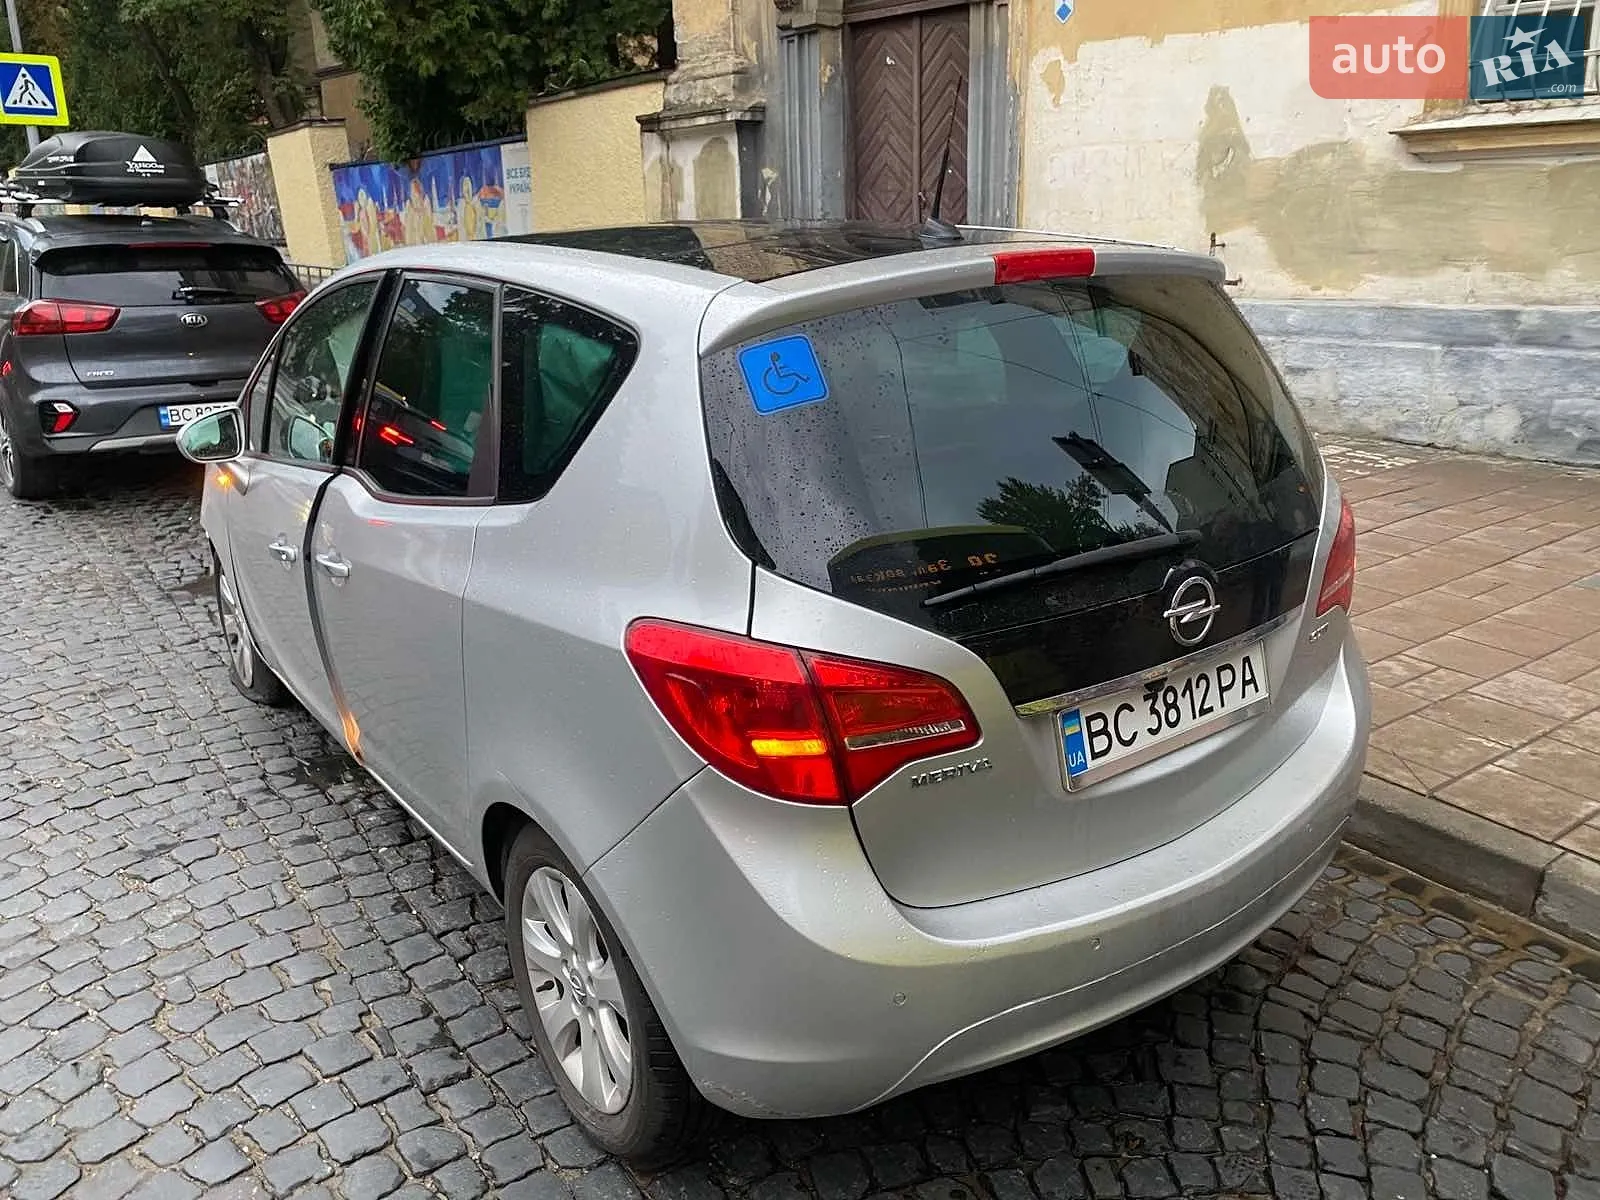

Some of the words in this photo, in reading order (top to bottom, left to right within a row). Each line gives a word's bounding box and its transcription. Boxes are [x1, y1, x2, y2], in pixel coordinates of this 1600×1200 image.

[183, 315, 205, 325] KIA
[1086, 703, 1138, 760] BC
[1143, 672, 1214, 735] 3812
[1216, 655, 1260, 708] PA
[1069, 751, 1085, 767] UA
